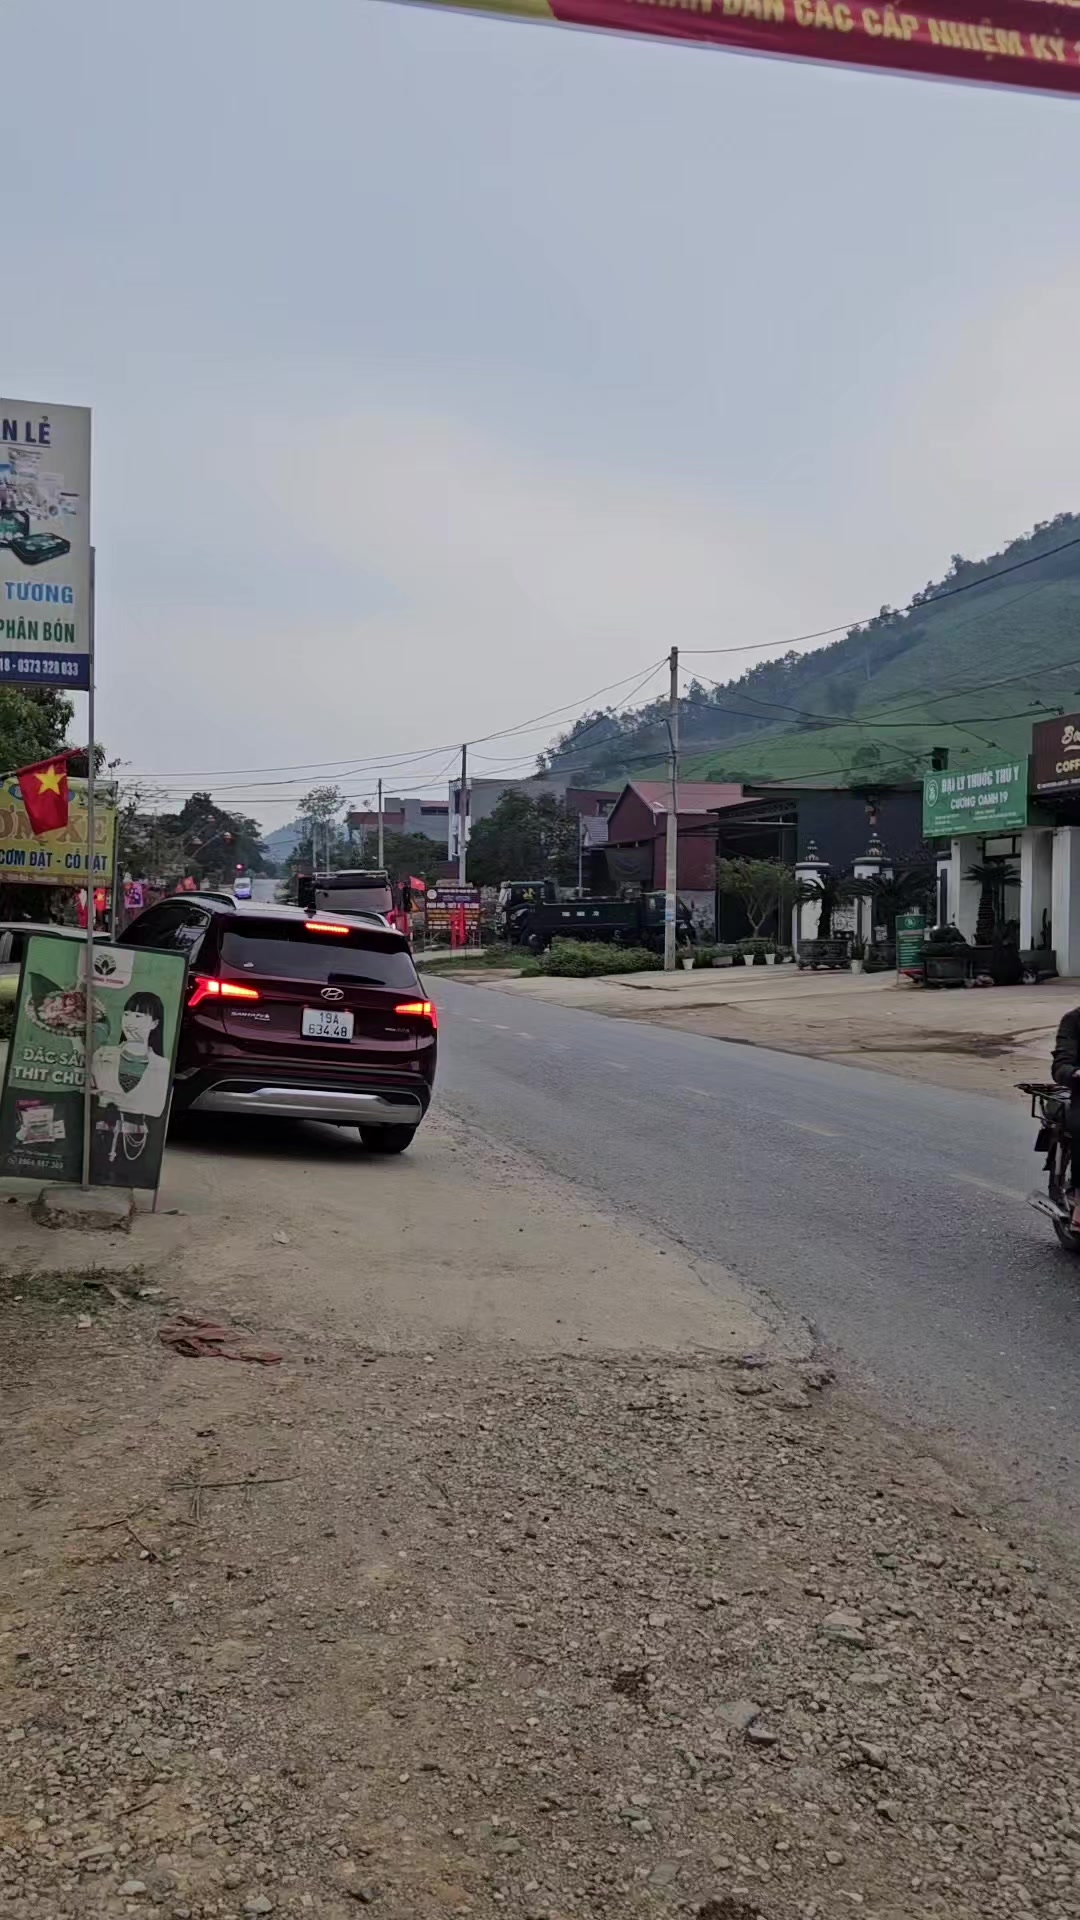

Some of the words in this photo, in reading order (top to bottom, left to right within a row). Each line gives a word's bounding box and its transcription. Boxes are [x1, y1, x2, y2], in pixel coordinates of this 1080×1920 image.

[928, 17, 1024, 60] NHIỆM
[26, 415, 51, 444] LẺ
[43, 618, 75, 643] BÓN
[320, 1012, 338, 1024] 19A
